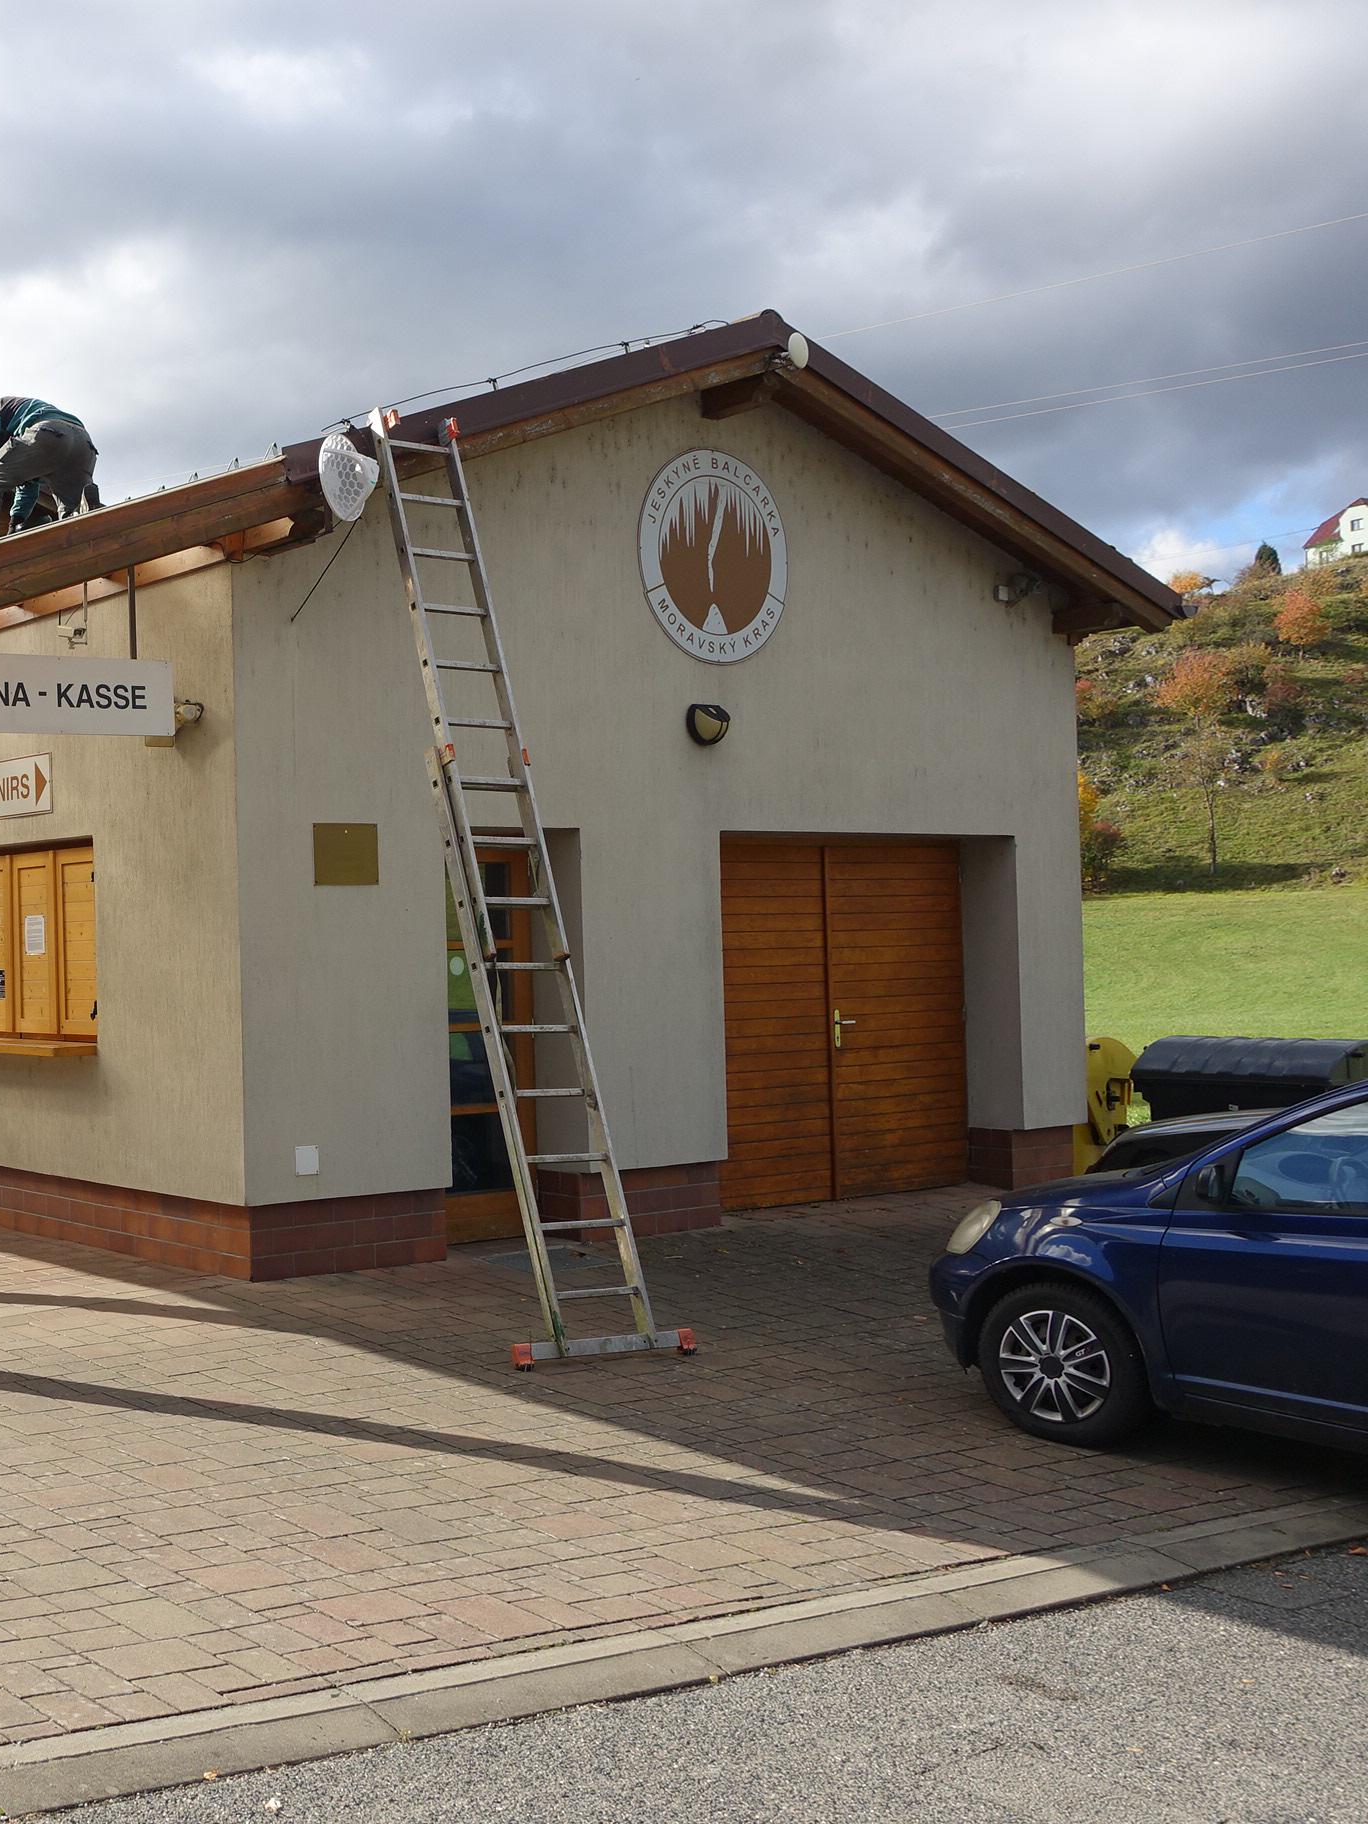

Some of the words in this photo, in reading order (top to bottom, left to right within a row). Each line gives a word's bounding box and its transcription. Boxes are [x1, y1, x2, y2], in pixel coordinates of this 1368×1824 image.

[649, 455, 701, 524] JESKYNĚ
[710, 457, 780, 538] BALCARKA
[657, 598, 737, 655] MORAVSKÝ
[743, 607, 776, 648] KRAS
[56, 682, 148, 710] KASSE
